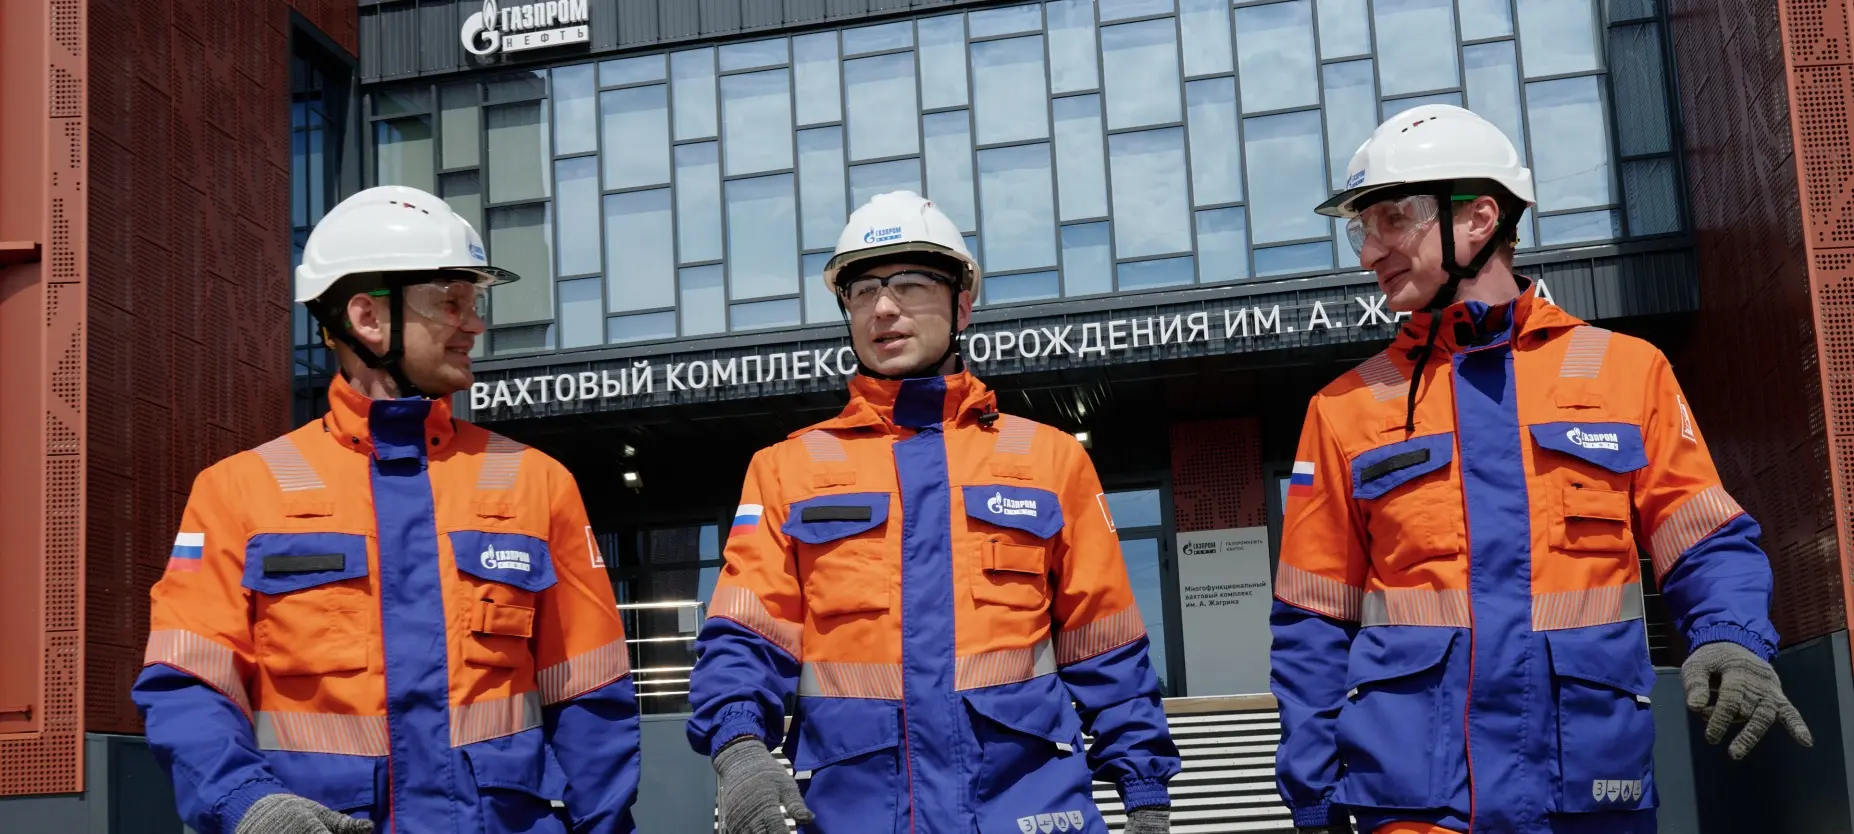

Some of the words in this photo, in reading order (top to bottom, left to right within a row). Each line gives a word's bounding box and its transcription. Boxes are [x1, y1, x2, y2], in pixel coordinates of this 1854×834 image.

[501, 0, 588, 32] ГАЗПРОМ
[506, 28, 584, 47] НЕФТЬ
[470, 360, 653, 410] ВАХТОВЫЙ
[666, 346, 858, 391] КОМПЛЕКС
[956, 312, 1209, 362] ОРОЖДЕНИЯ
[1224, 304, 1294, 339] ИМ.
[1308, 300, 1342, 331] А.
[1185, 581, 1266, 592] Многофункциональный
[1220, 590, 1253, 598] комплекс
